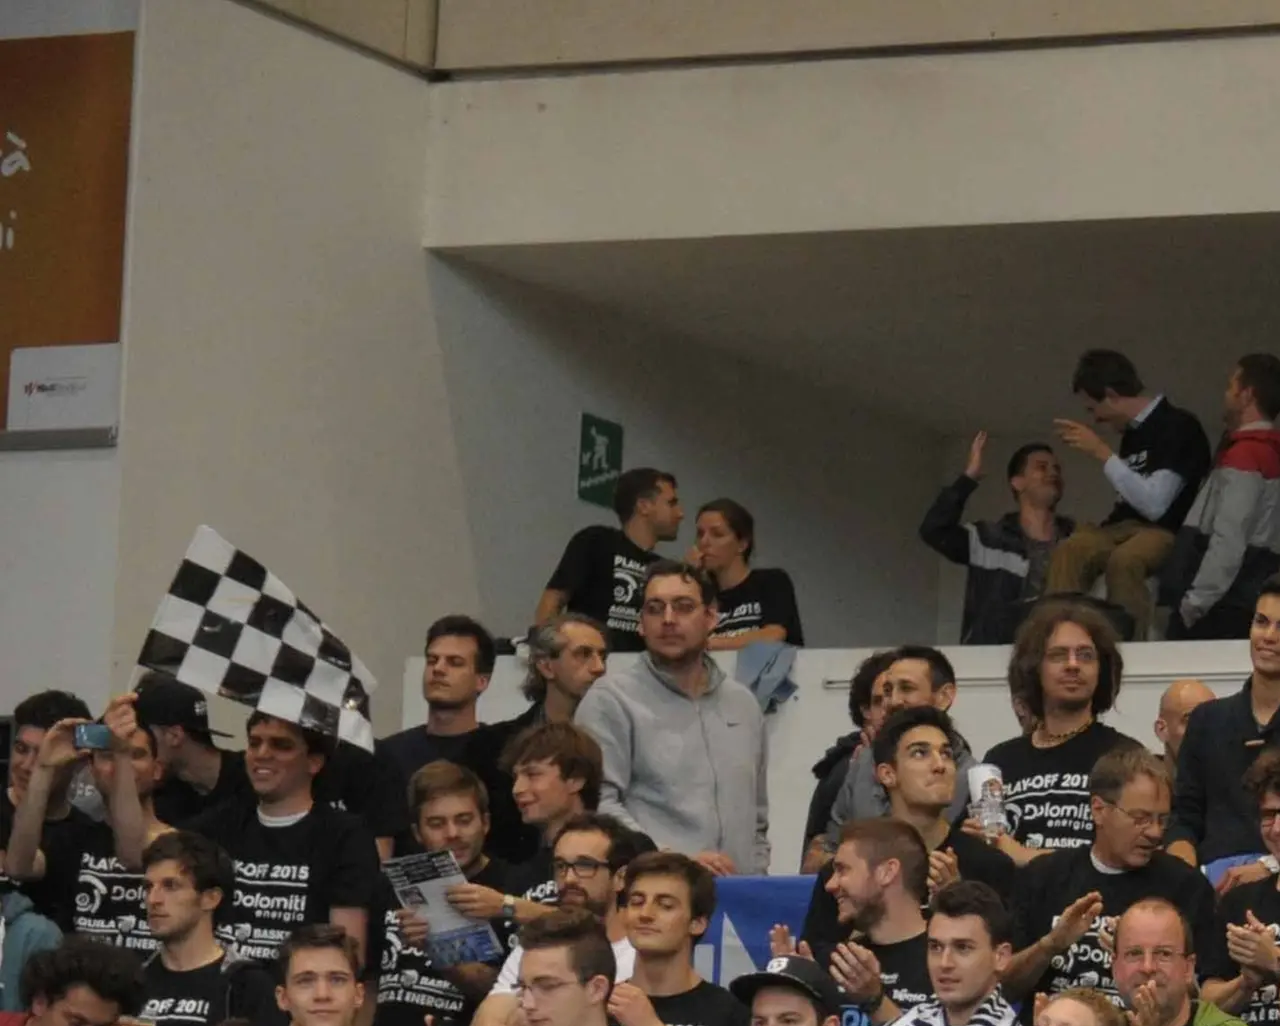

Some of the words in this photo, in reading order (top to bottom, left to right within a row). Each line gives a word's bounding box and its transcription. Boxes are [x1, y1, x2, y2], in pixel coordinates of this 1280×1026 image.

[1060, 772, 1089, 788] 201
[82, 852, 126, 871] PLAY-
[270, 864, 310, 881] 2015
[255, 910, 304, 923] energia
